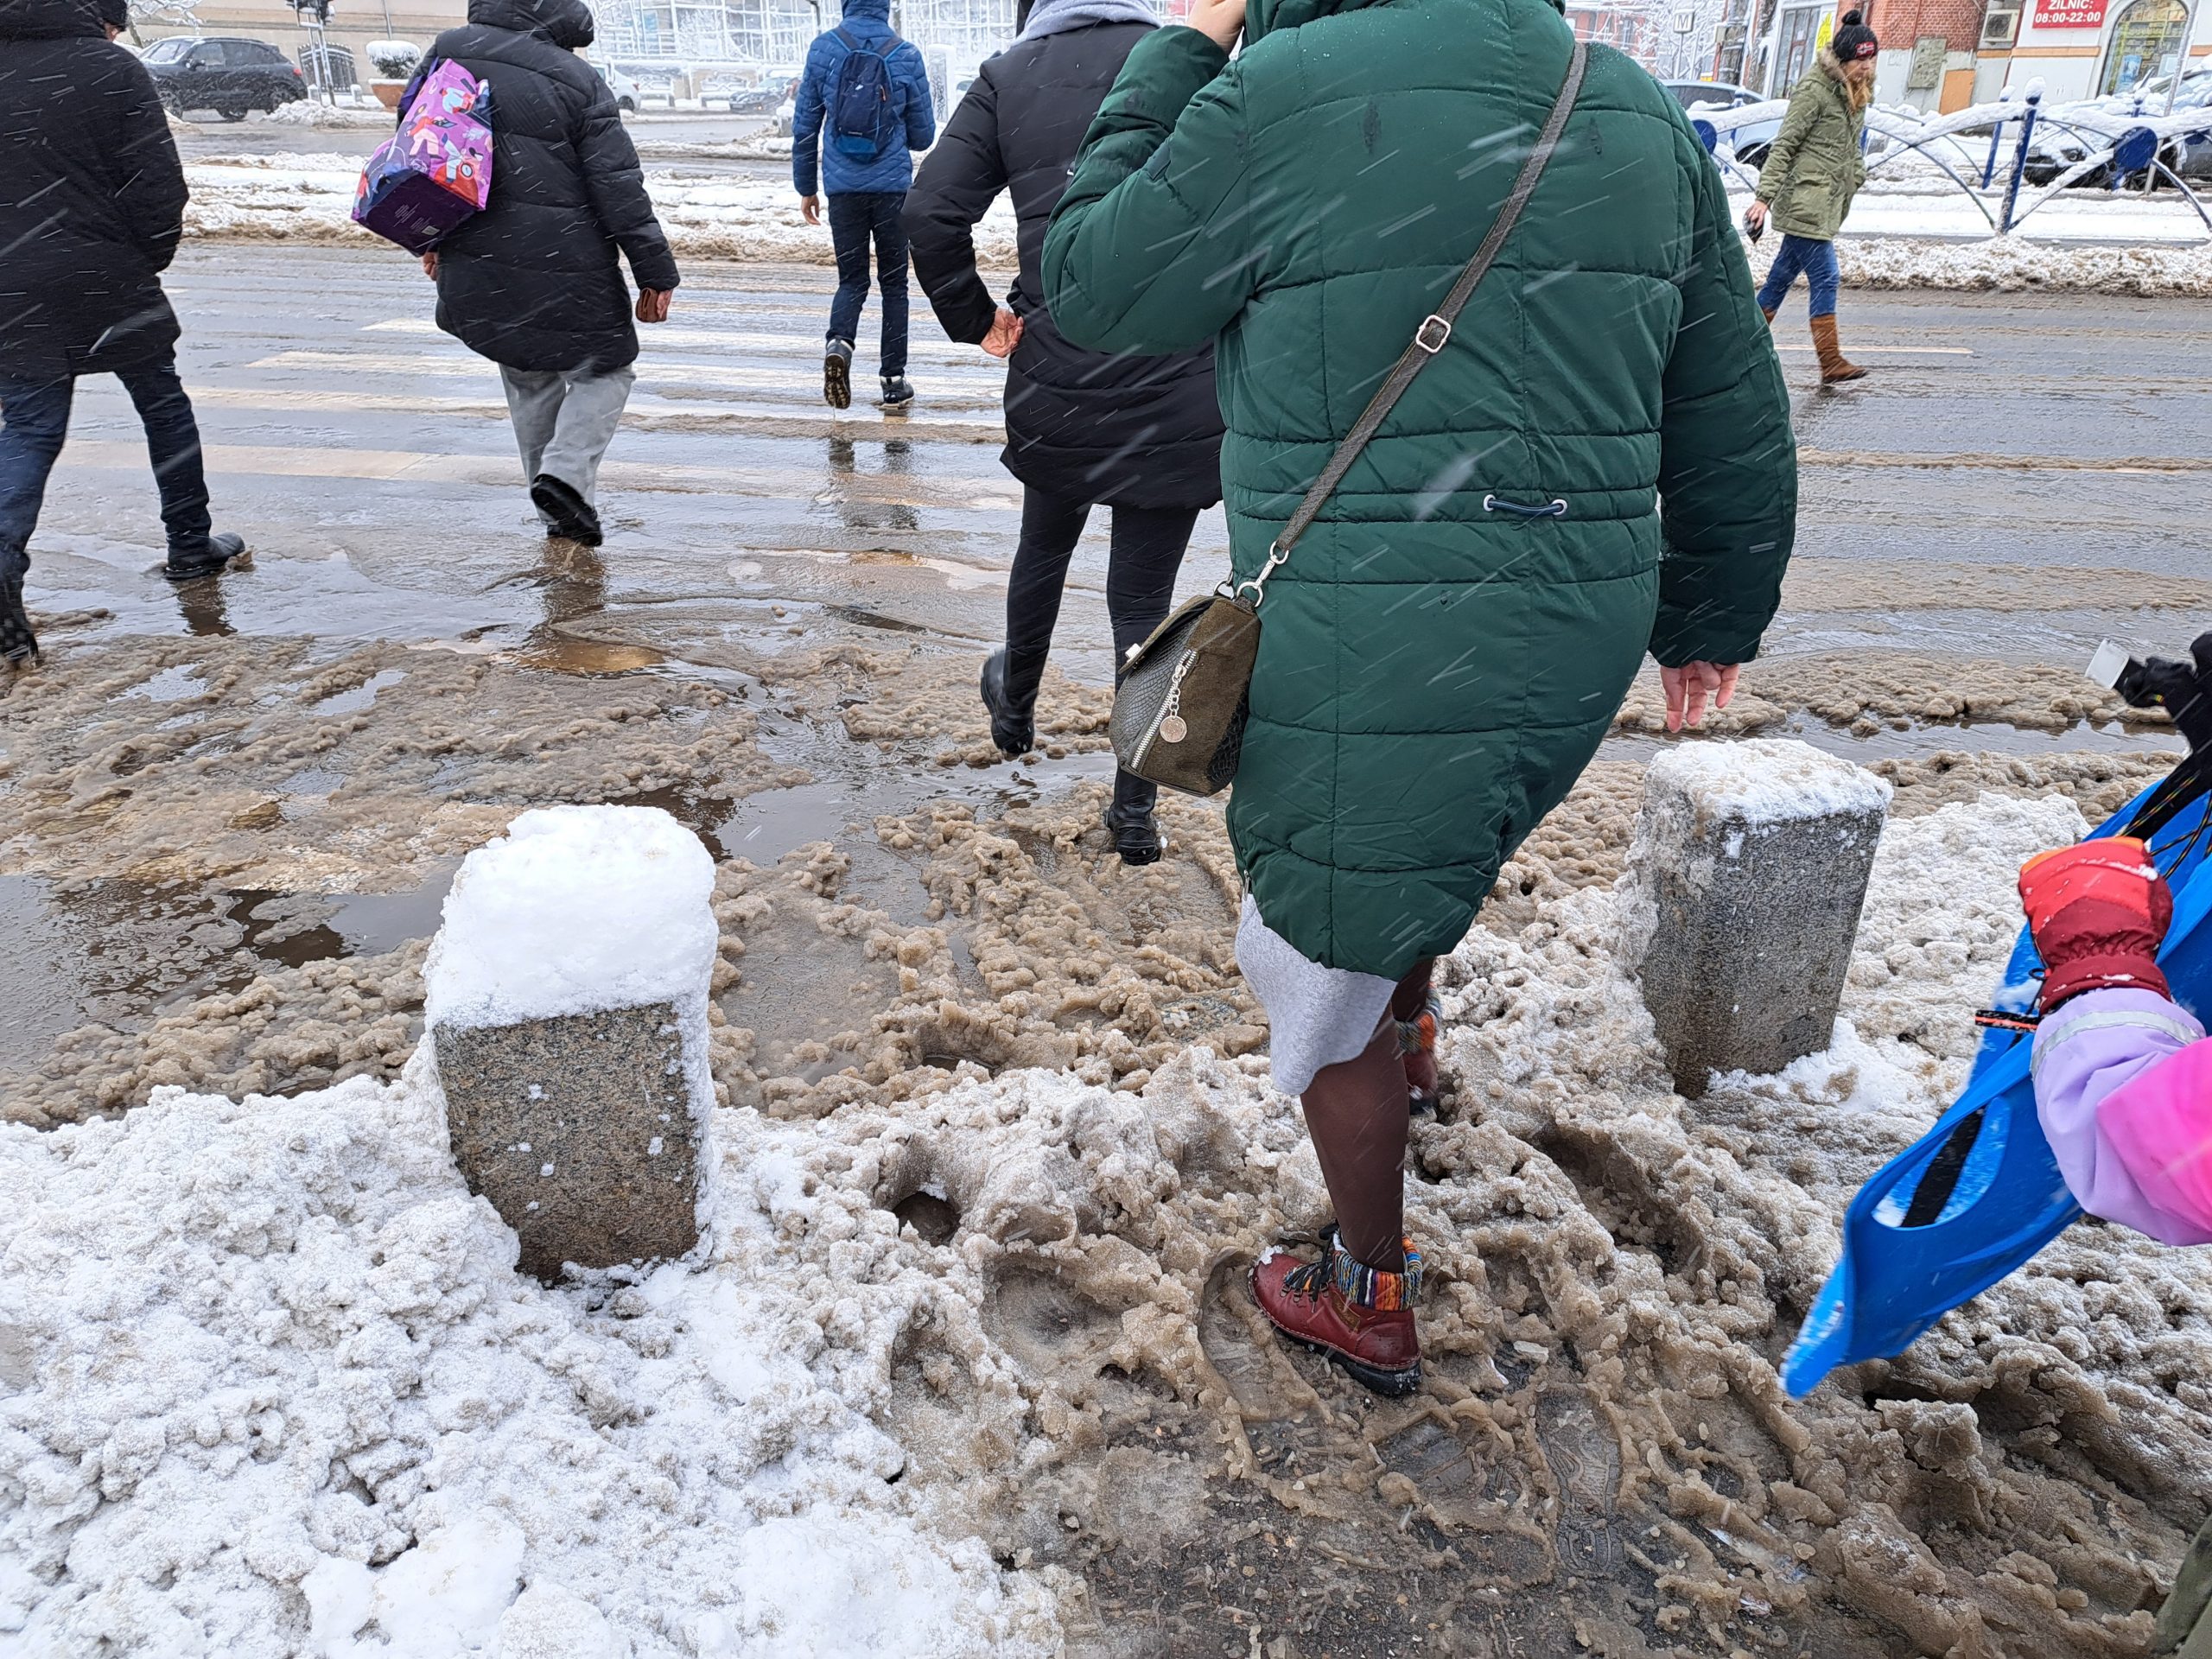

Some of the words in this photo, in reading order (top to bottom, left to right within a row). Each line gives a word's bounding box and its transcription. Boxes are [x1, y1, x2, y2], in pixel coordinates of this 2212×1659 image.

[2048, 0, 2093, 10] ZILNIC:
[1677, 14, 1689, 29] M
[2035, 11, 2101, 22] 08:00-22:00
